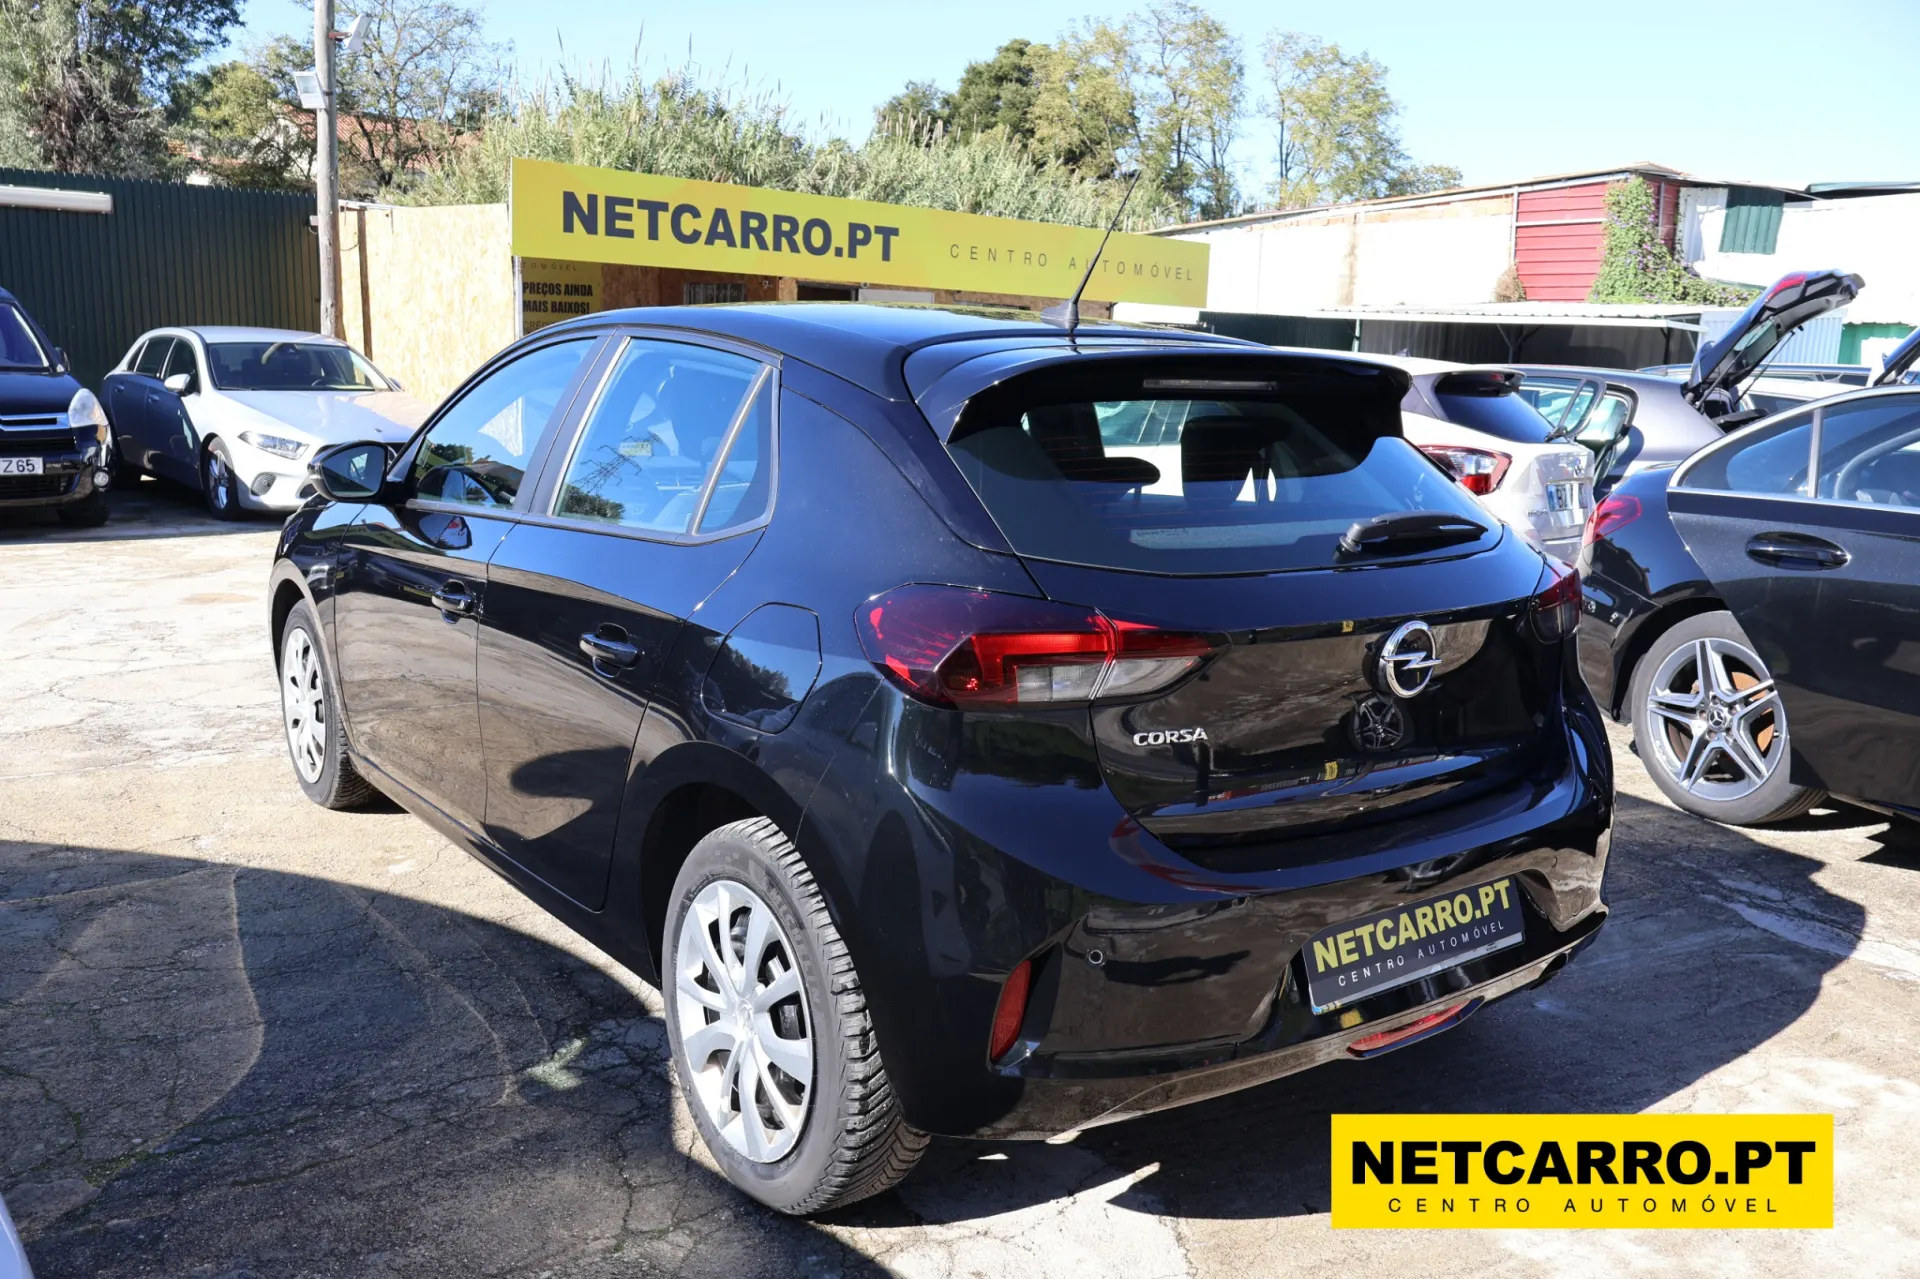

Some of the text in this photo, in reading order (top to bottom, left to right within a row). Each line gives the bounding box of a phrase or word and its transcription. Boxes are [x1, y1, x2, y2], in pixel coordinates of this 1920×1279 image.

[562, 190, 899, 263] NETCARRO.PT
[522, 261, 577, 272] TOMÓVEL
[950, 244, 1193, 281] CENTRO AUTOMÓVEL
[523, 281, 594, 298] PREÇOS AINDA
[523, 299, 590, 314] MAIS BAIXOS!
[16, 459, 36, 473] 65
[1132, 727, 1209, 747] CORSA
[1312, 878, 1512, 973] NETCARRO.PT
[1338, 920, 1505, 987] CENTRO AUTOMÓVEL
